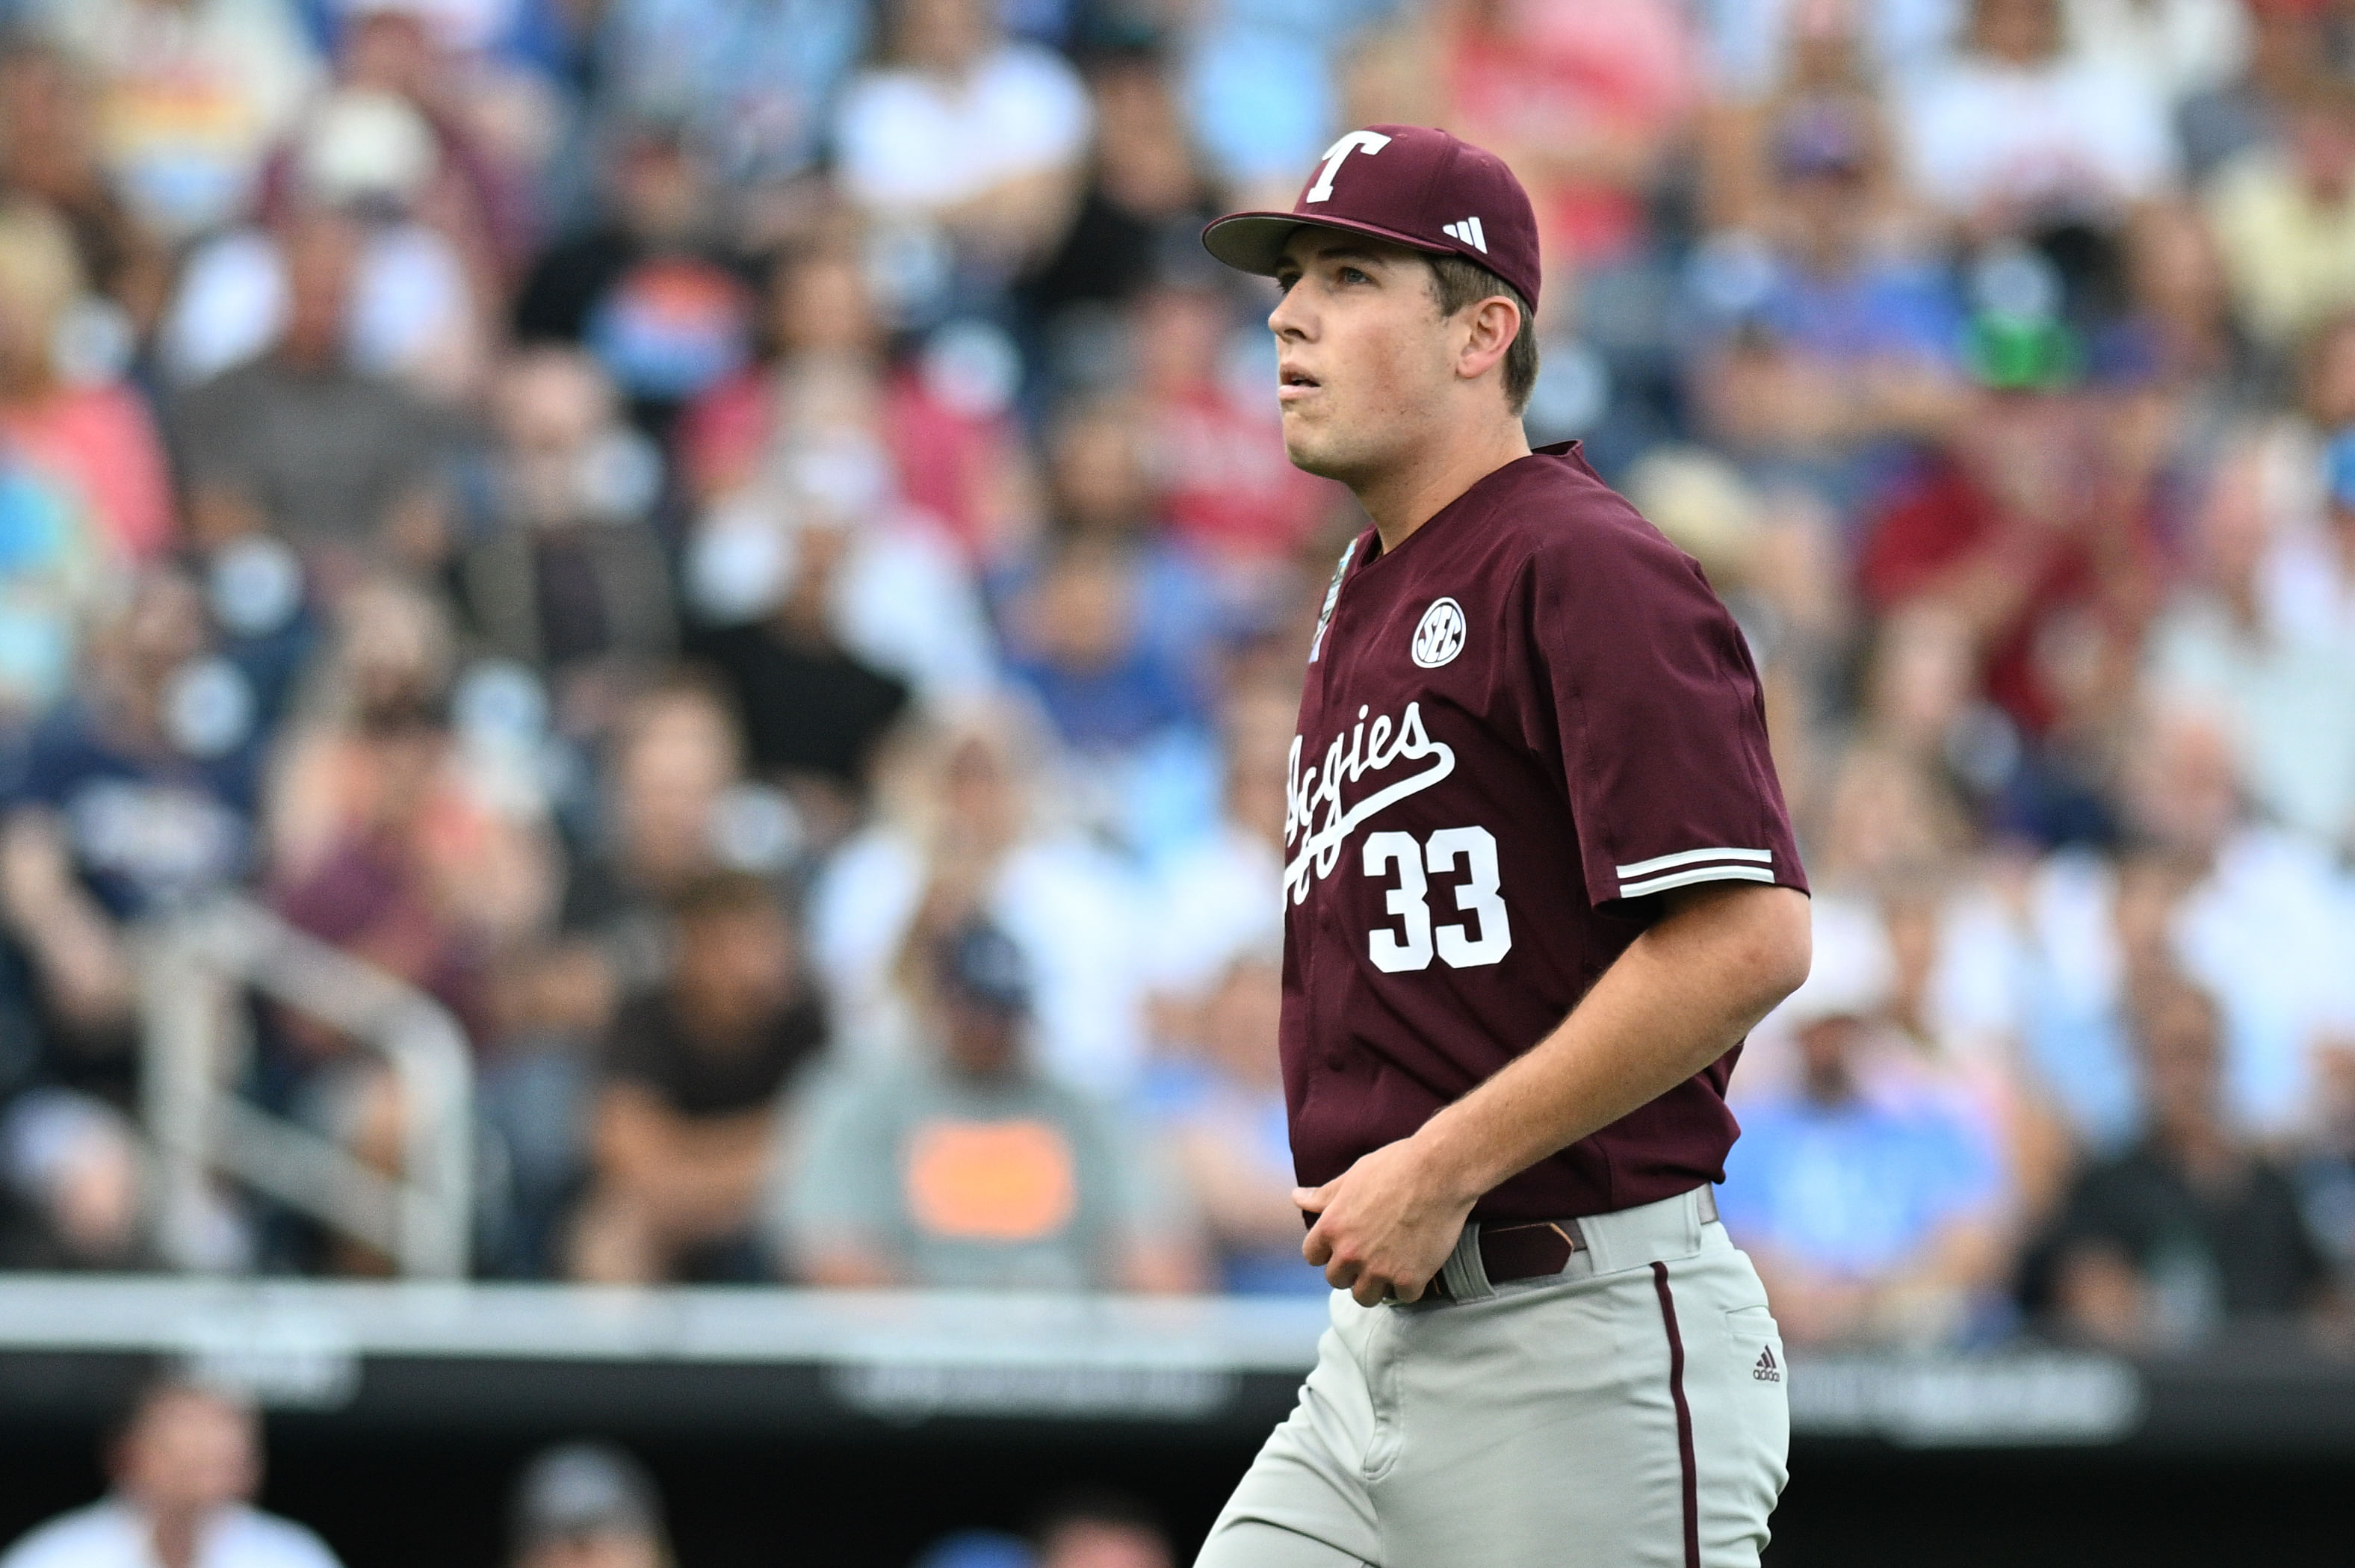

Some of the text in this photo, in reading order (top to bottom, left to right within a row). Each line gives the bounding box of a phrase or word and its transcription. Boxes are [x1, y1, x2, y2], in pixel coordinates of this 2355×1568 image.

[1306, 130, 1392, 203] T
[1417, 605, 1461, 663] SEC
[1362, 825, 1512, 973] 33
[1753, 1369, 1780, 1382] adidas
